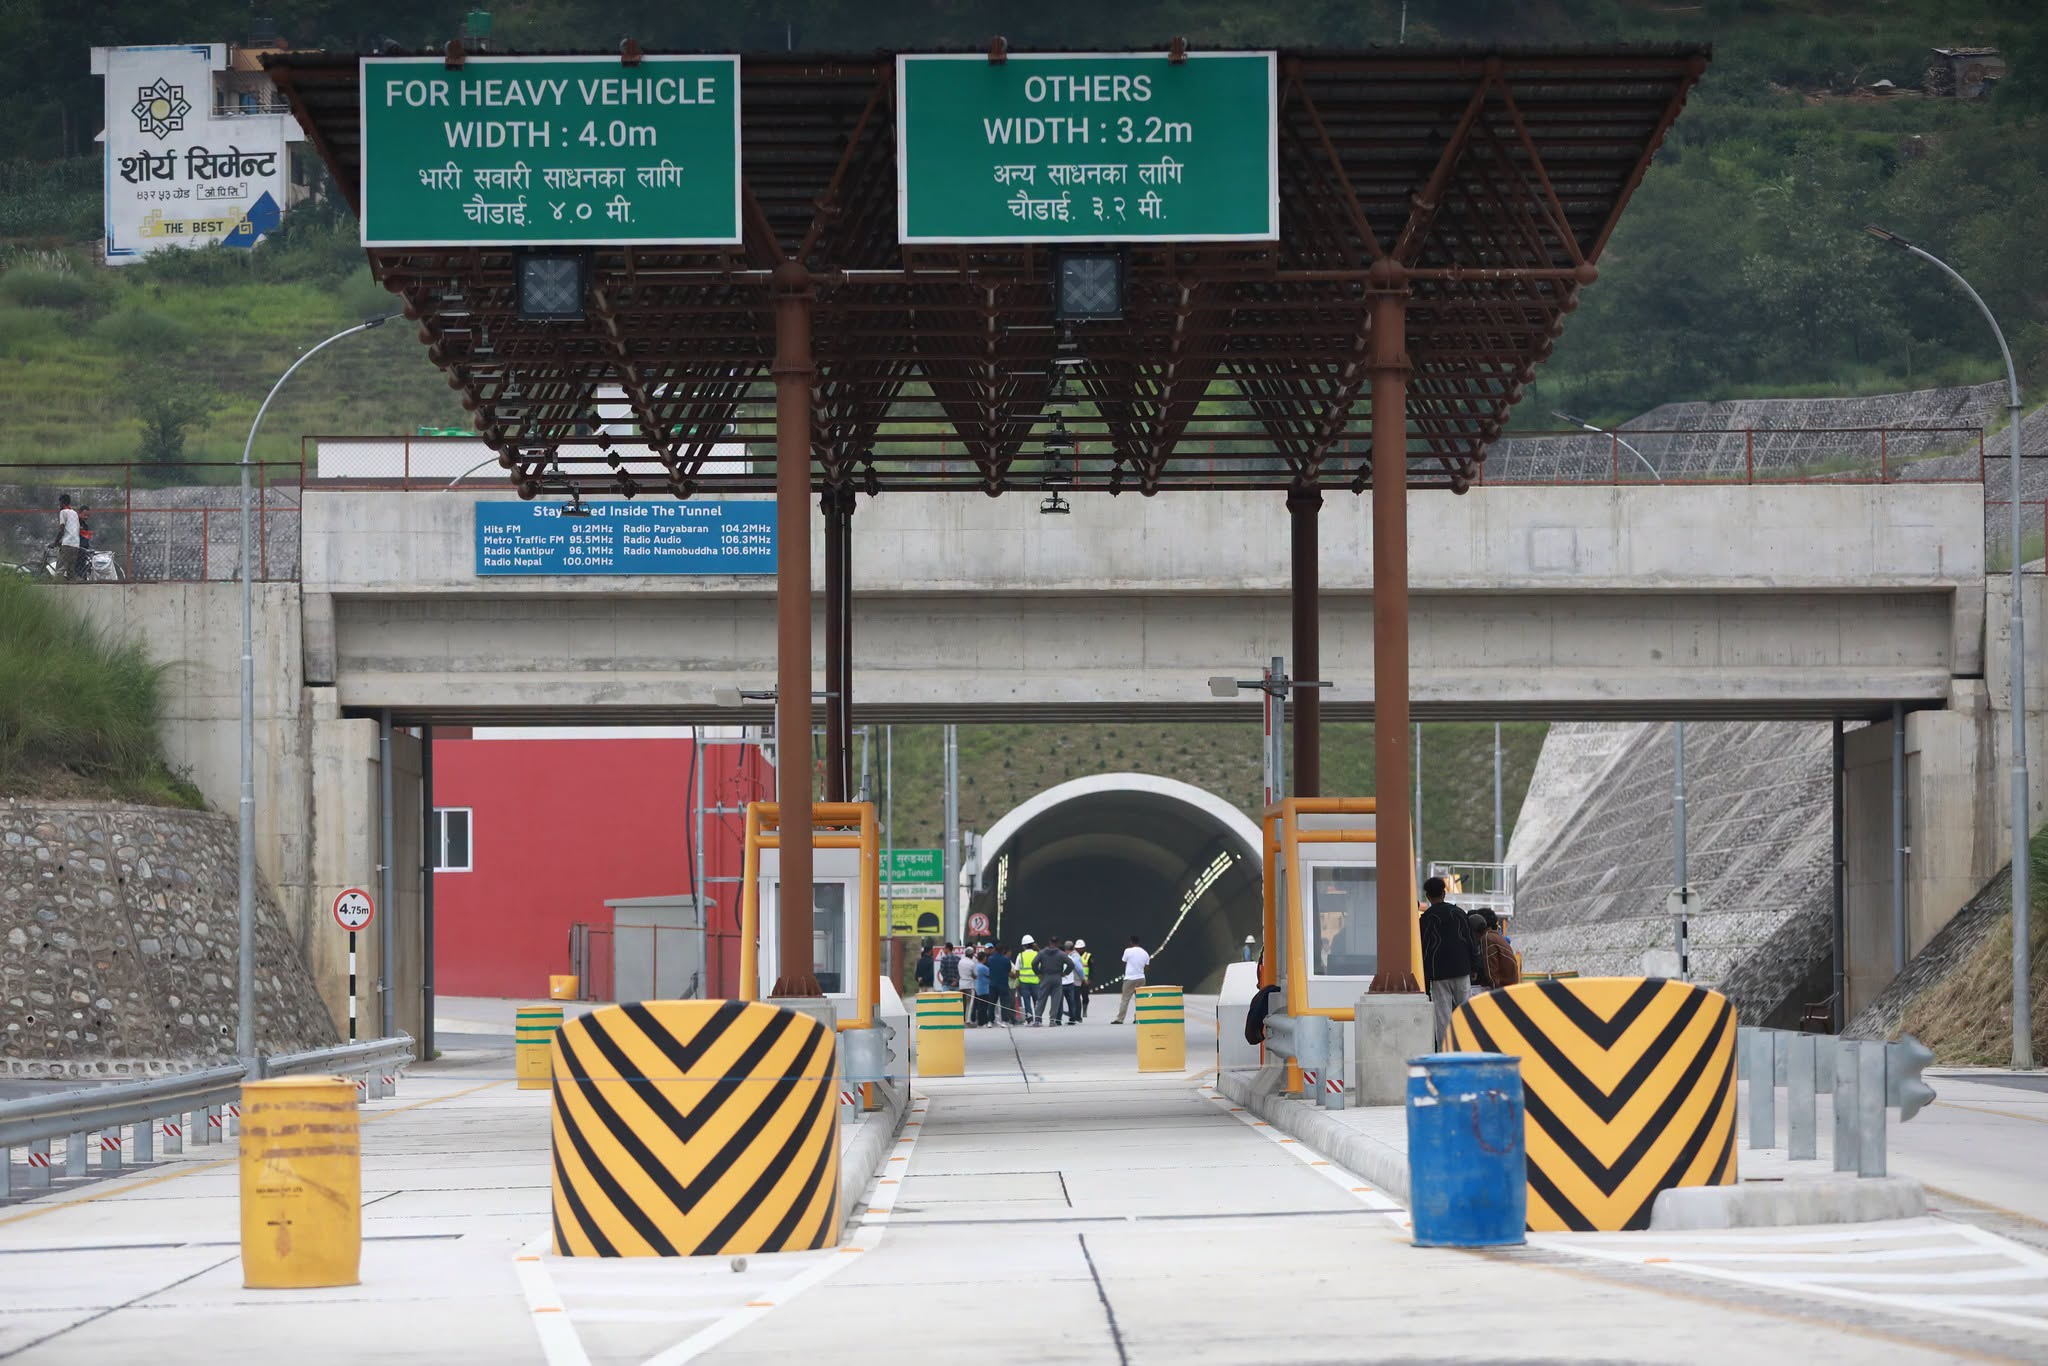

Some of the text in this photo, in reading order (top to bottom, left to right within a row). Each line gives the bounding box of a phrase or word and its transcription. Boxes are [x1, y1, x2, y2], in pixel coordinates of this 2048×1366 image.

[386, 78, 716, 107] FOR HEAVY VEHICLE
[1025, 76, 1152, 102] OTHERS
[445, 121, 550, 148] WIDTH
[578, 120, 657, 147] 4.0m
[984, 118, 1090, 144] WIDTH
[1117, 117, 1193, 143] 3.2m
[118, 145, 277, 184] शौर्य सिमेन्ट
[993, 156, 1184, 186] अन्य साधनका लागि
[418, 159, 683, 190] भारी सवारी साधनका लागि
[606, 195, 636, 222] मी.
[1138, 191, 1167, 219] मी.
[164, 220, 225, 234] THE BEST
[533, 505, 722, 518] Stay Ted Inside The Tunnel
[484, 524, 613, 534] Hits FM 91.2MHz
[623, 524, 771, 535] Radio Paryabaran 104.2MHz
[484, 535, 613, 545] Metro Traffic FM 95.5MHz
[623, 535, 771, 544] Radio Audio 106.3MHz
[484, 546, 511, 556] Radio
[513, 546, 555, 557] Kantipur
[623, 546, 771, 555] Radio Namobuddha 106.6MHz
[484, 556, 613, 568] Radio Nepal 100.0MHz
[339, 903, 369, 915] 4.75m
